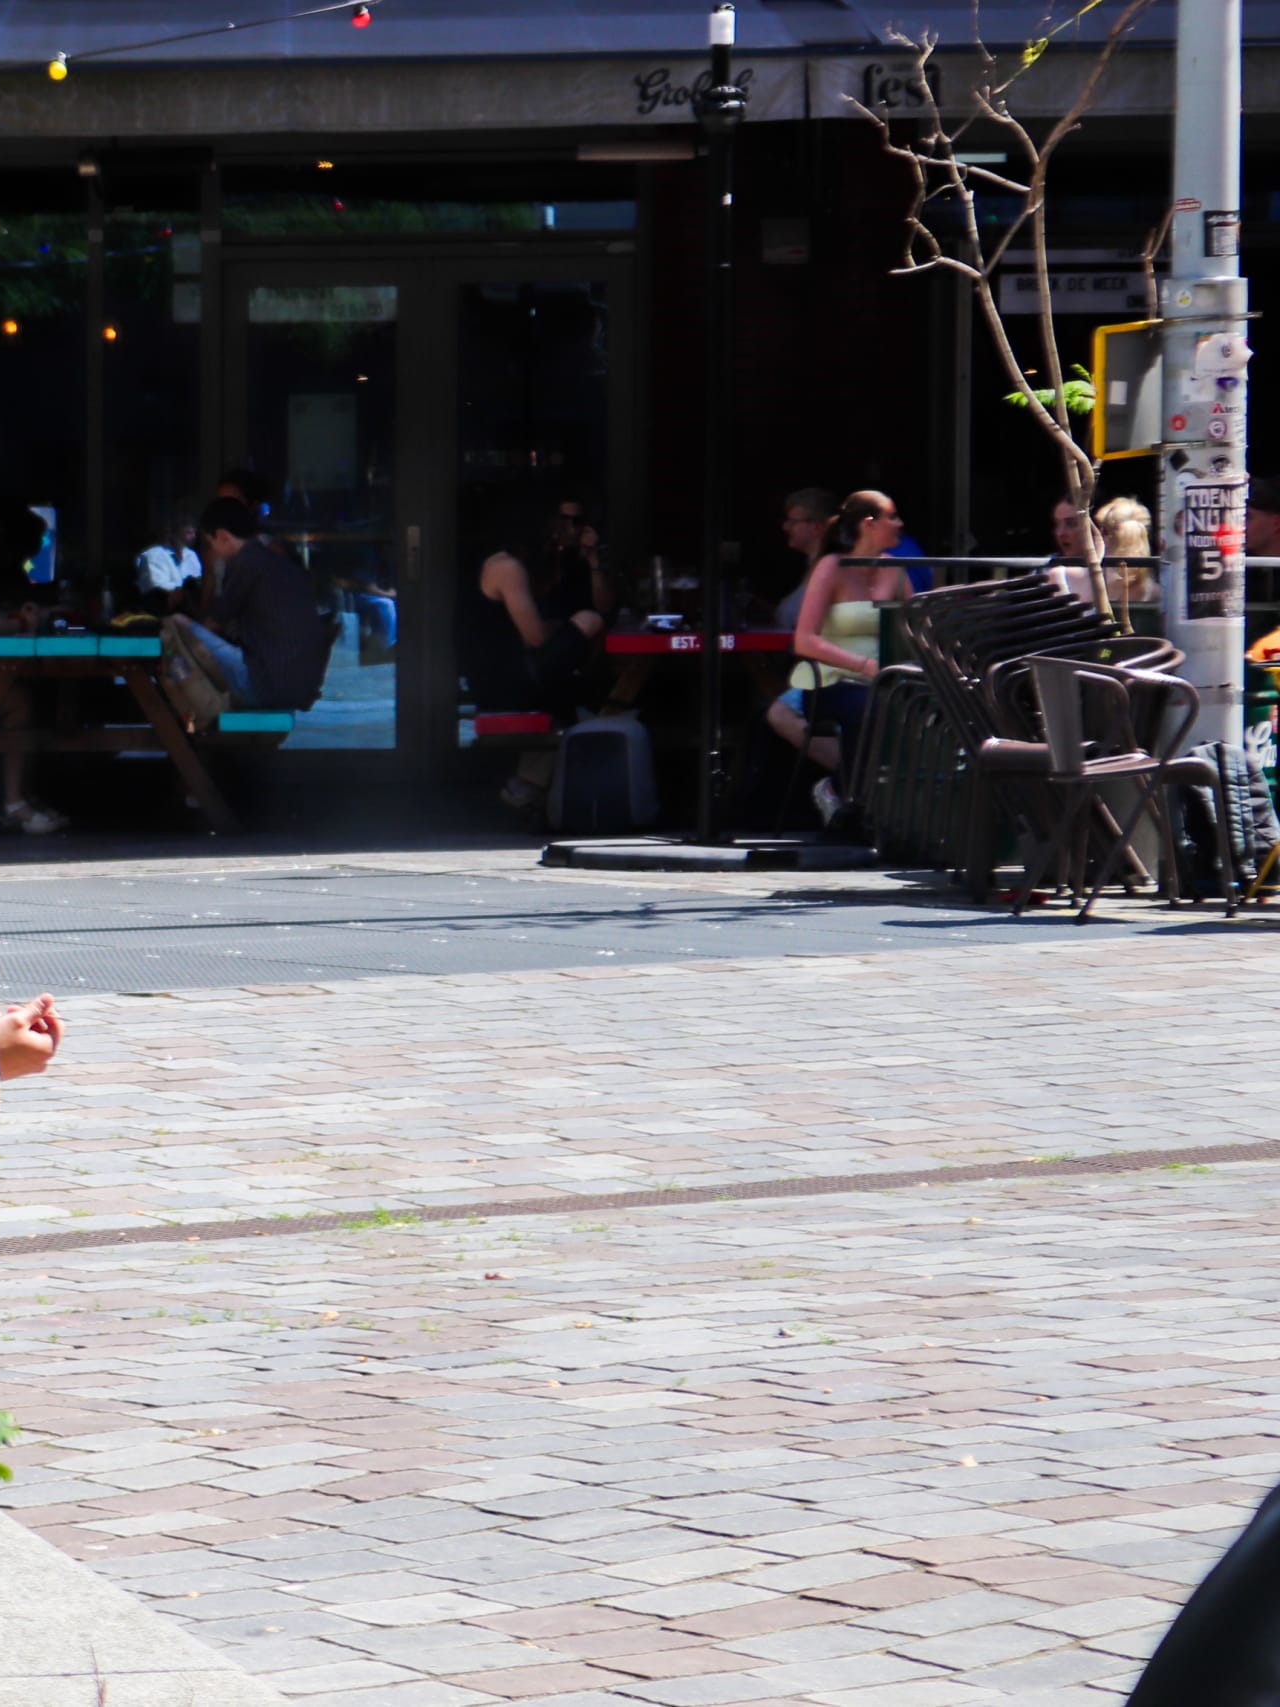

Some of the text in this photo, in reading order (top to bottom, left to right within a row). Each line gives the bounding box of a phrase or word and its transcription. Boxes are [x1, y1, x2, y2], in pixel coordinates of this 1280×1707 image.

[1187, 509, 1220, 532] NU
[1200, 550, 1224, 581] 5
[671, 635, 700, 650] EST.
